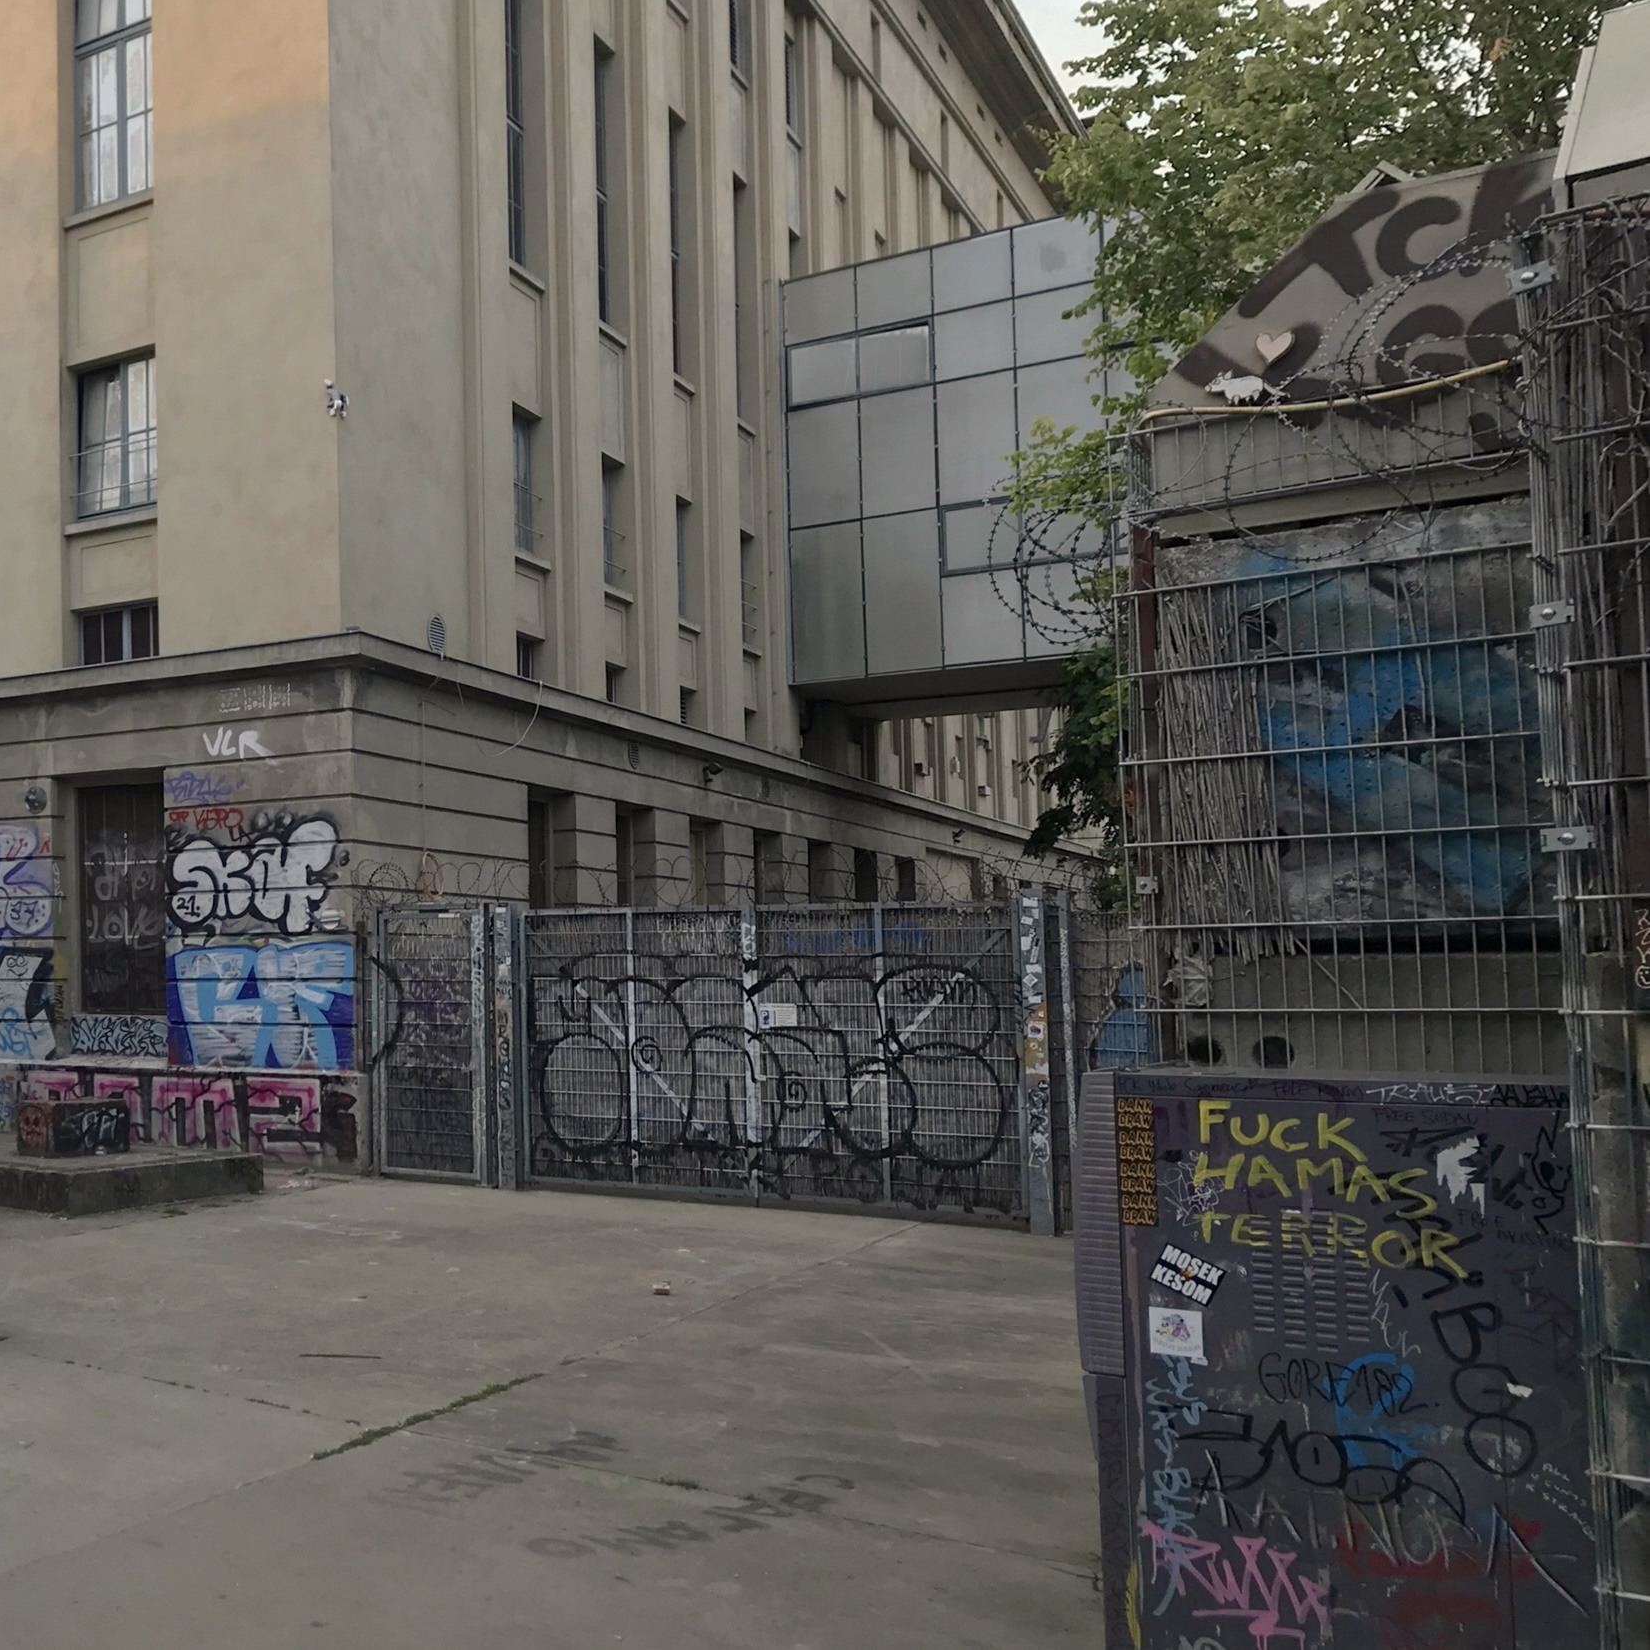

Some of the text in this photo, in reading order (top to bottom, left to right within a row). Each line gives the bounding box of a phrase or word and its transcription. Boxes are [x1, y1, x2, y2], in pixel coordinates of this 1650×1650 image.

[1118, 1099, 1153, 1113] DANK
[1118, 1113, 1153, 1128] DRAW
[1371, 1107, 1415, 1123] FREE
[1119, 1130, 1155, 1146] DANK
[1199, 1100, 1369, 1163] FUCK
[1119, 1145, 1155, 1160] DRAW
[1120, 1163, 1156, 1178] DANK
[1121, 1178, 1156, 1193] DRAW
[1192, 1152, 1438, 1219] HAMAS
[1122, 1194, 1158, 1209] DANK
[1123, 1209, 1158, 1225] DRAW
[1193, 1211, 1470, 1279] TERROR
[1160, 1244, 1224, 1286] MOSEK
[1150, 1263, 1213, 1305] KESOM
